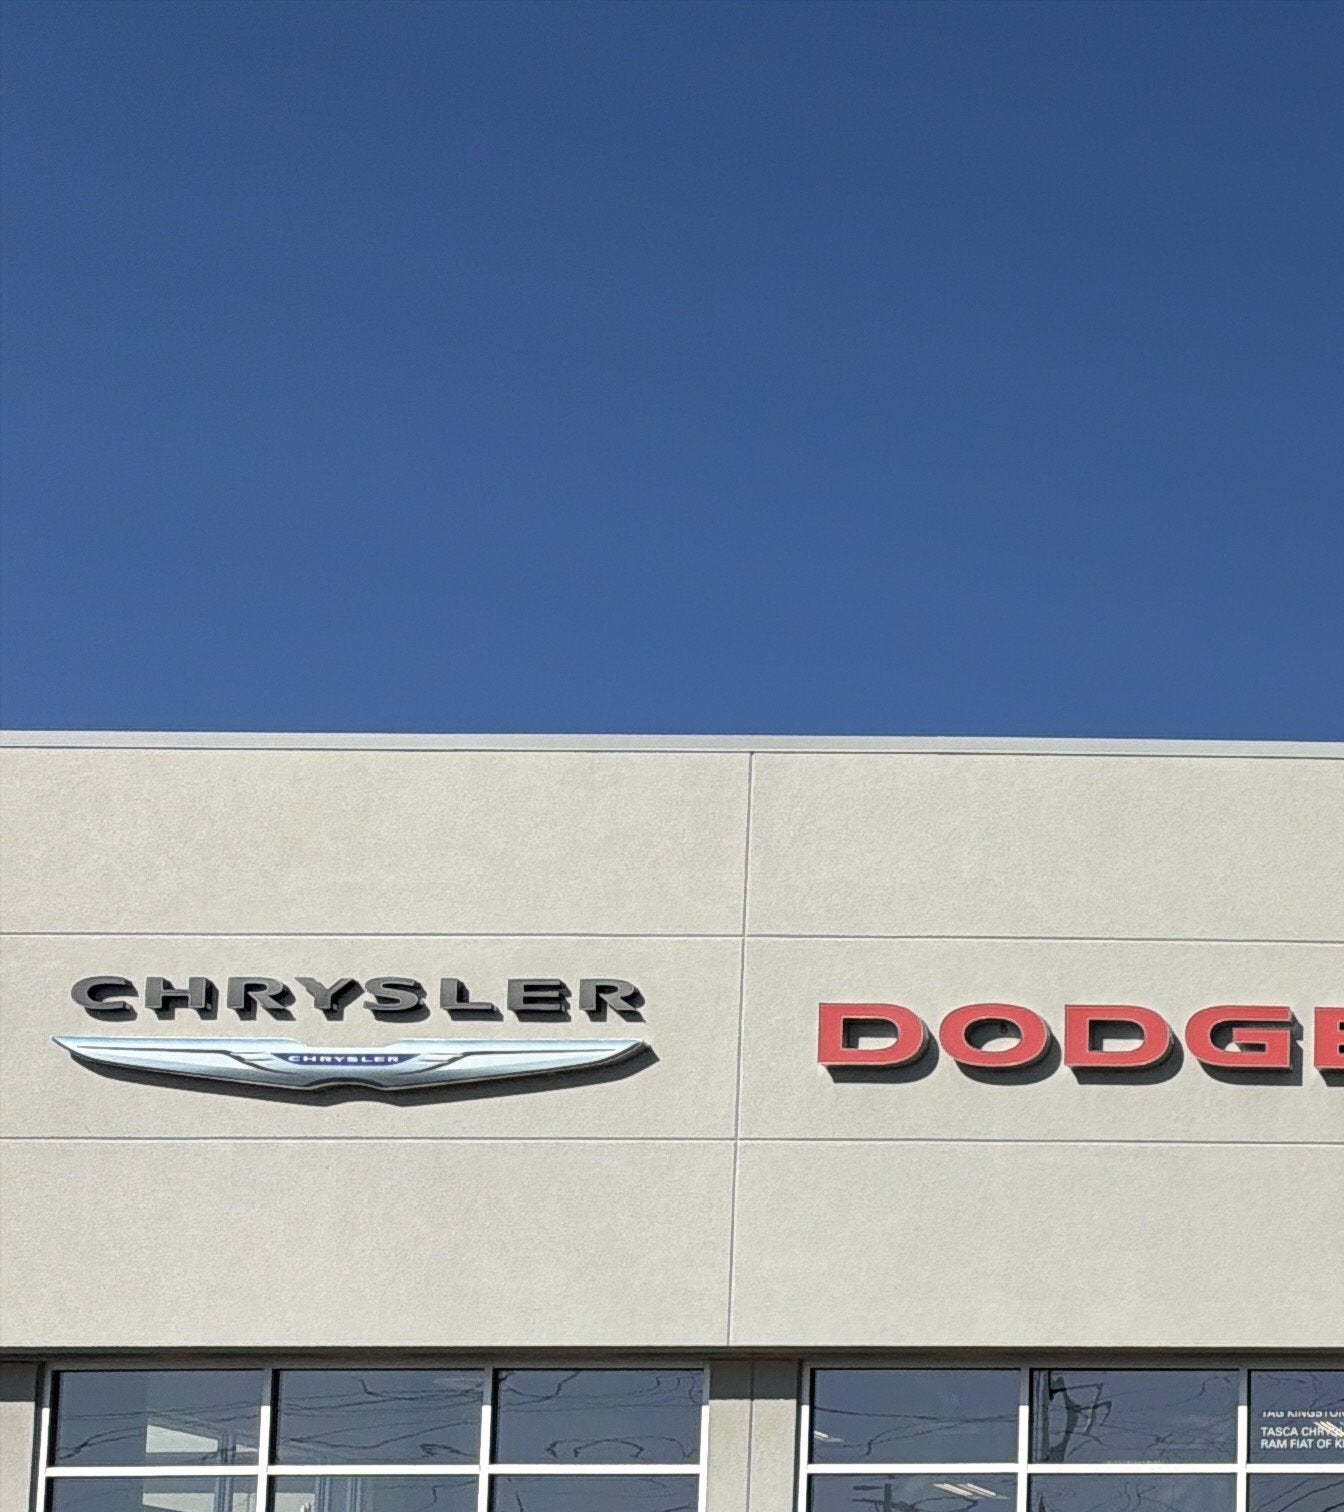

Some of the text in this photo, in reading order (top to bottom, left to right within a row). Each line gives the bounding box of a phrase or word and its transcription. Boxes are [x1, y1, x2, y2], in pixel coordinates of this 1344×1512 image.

[70, 975, 647, 1019] CHRYSLER
[288, 1055, 399, 1063] CHRYSLER
[1261, 1426, 1299, 1437] TASCA
[1261, 1438, 1288, 1449] RAM
[1290, 1438, 1313, 1449] FIAT
[1316, 1438, 1332, 1449] OF
